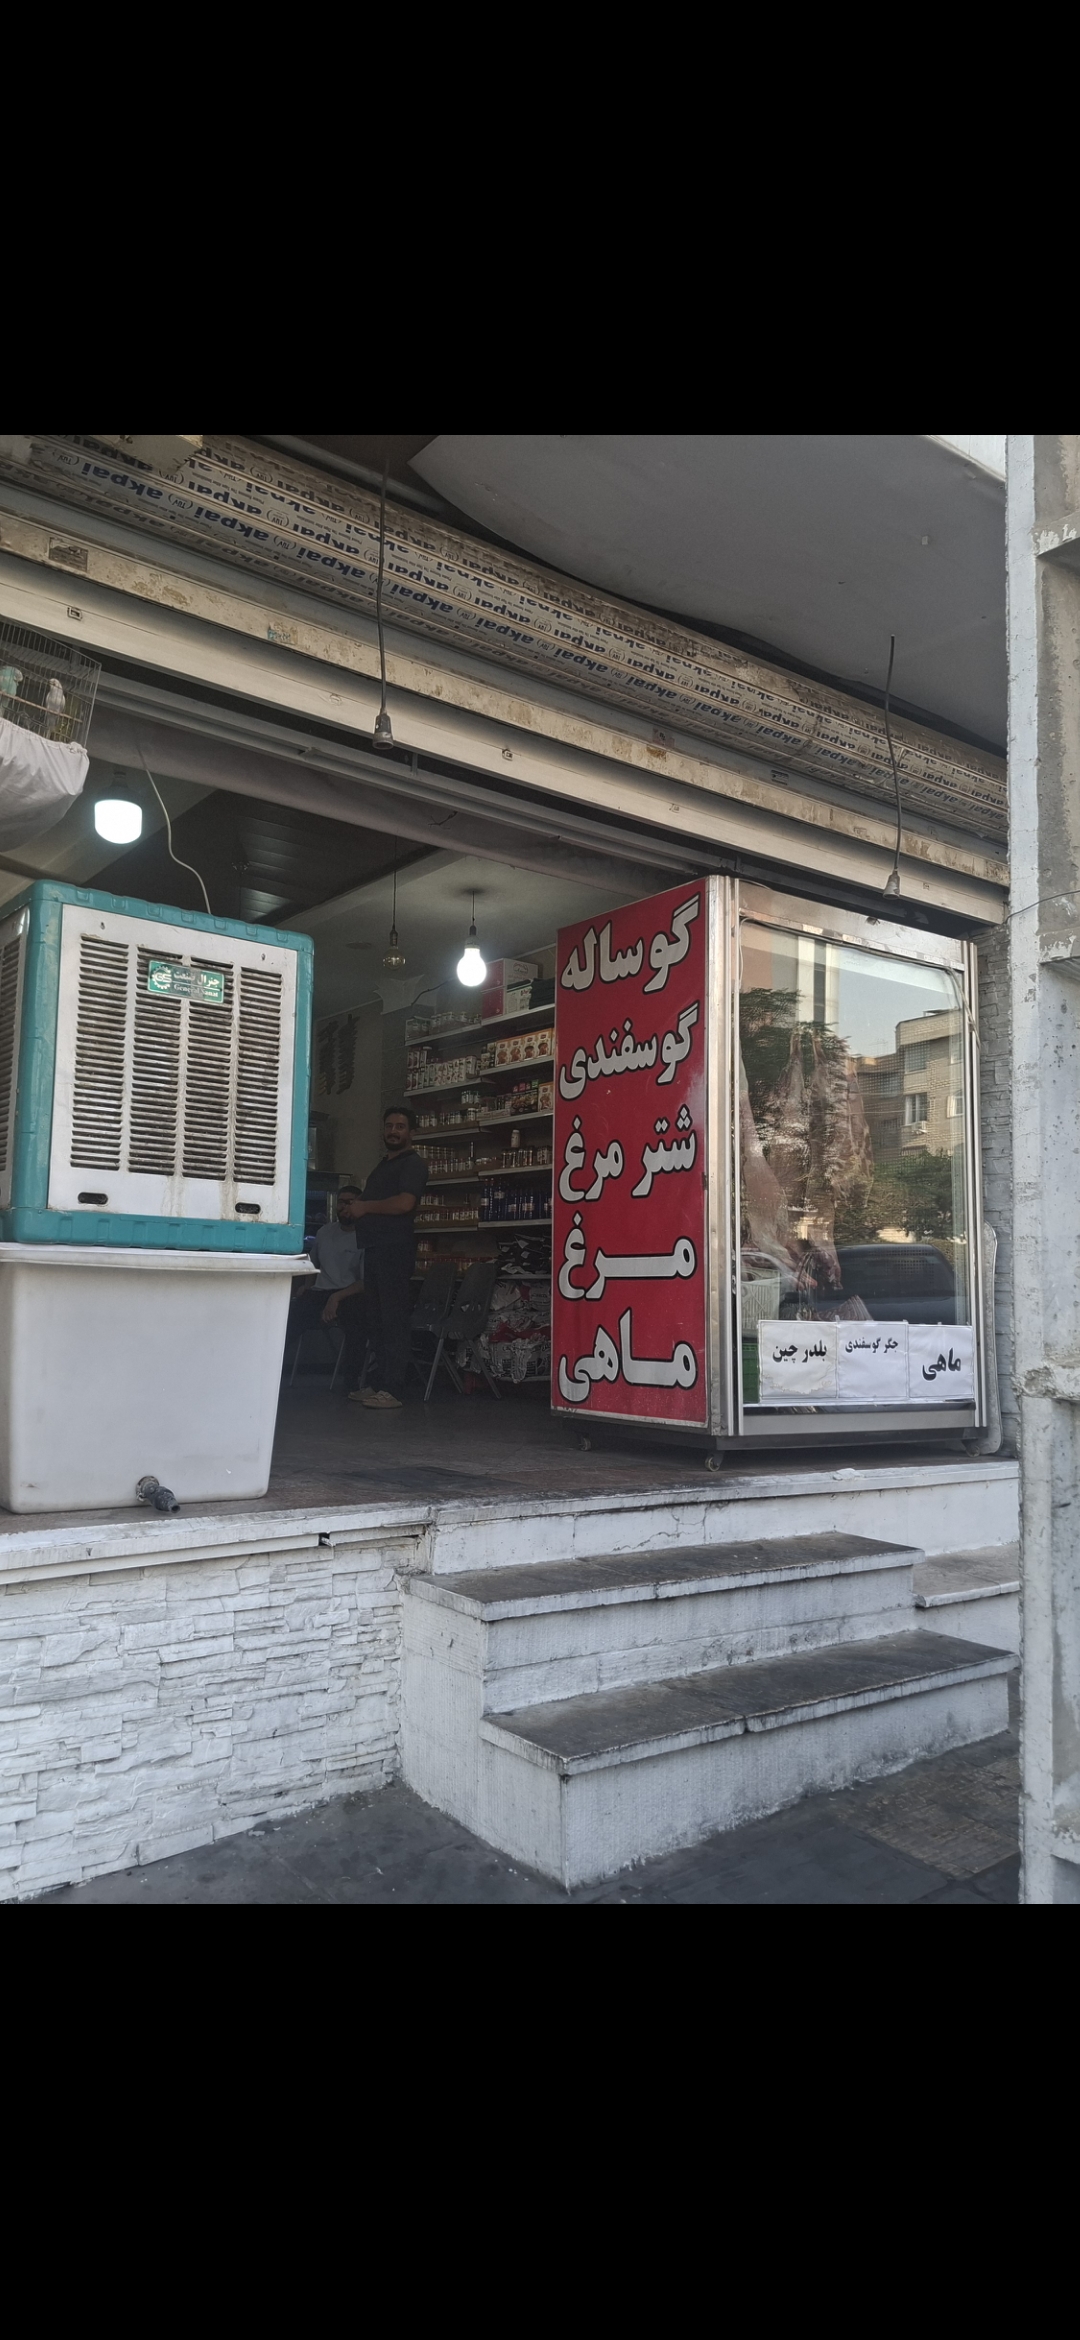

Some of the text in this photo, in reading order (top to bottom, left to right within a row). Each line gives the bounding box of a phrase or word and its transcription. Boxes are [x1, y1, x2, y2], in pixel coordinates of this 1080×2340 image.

[198, 447, 245, 471] akp
[80, 462, 163, 501] akpai
[172, 499, 186, 509] TÜV
[188, 481, 261, 515] akpai
[194, 506, 269, 543] akpai
[277, 541, 290, 550] TÜV
[291, 524, 359, 555] akpai
[296, 547, 365, 581] akpai
[387, 562, 448, 591] akpai
[390, 584, 453, 613] akpai
[474, 597, 530, 624] akpai
[475, 618, 534, 645] akpai
[553, 648, 608, 674] akpai
[627, 676, 677, 700] akpai
[695, 702, 741, 723] akpai
[757, 725, 801, 747] akpai
[560, 894, 700, 993] گوساله
[559, 1001, 699, 1101] گوسفندی
[558, 1105, 697, 1203] شتر مرغ
[558, 1212, 697, 1301] مرغ
[558, 1306, 697, 1403] ماهی
[845, 1337, 899, 1353] جگر گوسفندی
[921, 1347, 962, 1381] ماهی
